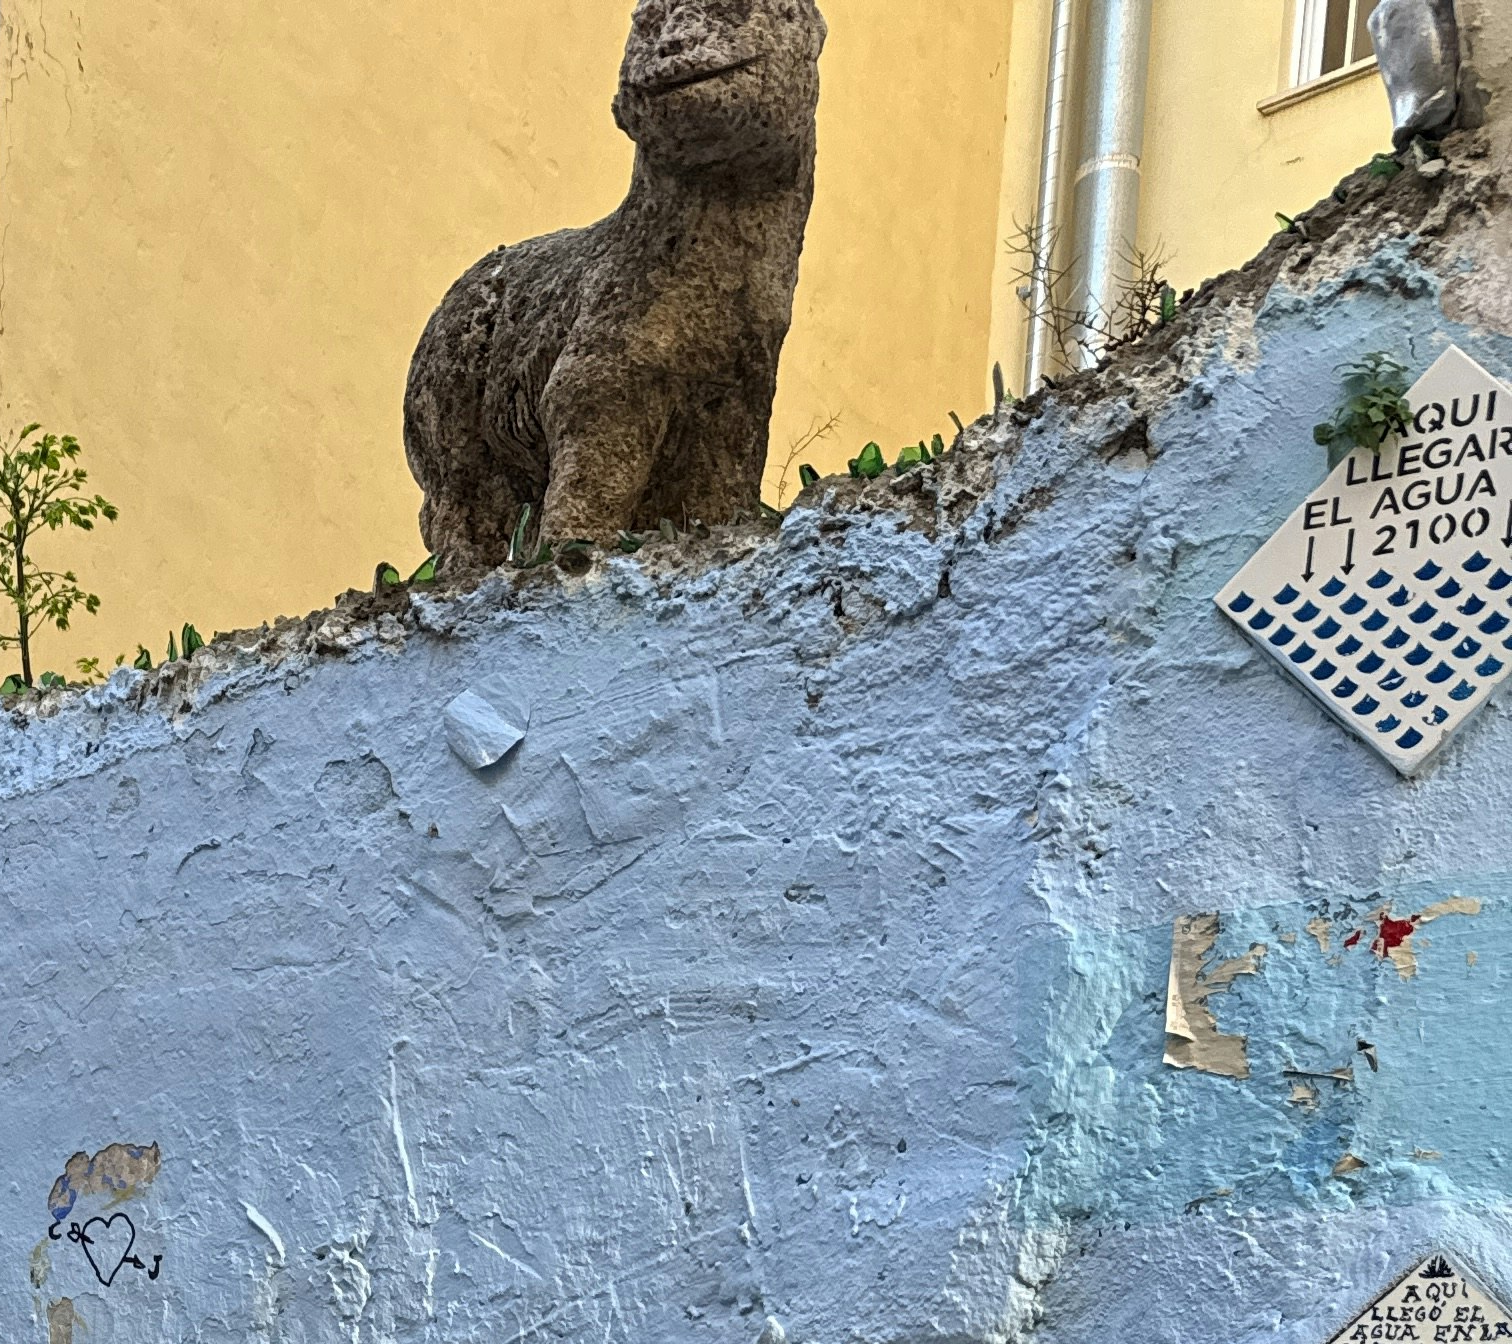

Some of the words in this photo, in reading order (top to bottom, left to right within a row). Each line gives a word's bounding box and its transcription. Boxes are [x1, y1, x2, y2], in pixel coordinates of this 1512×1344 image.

[1303, 497, 1353, 530] EL
[1370, 469, 1497, 519] AGUA
[1372, 506, 1490, 556] 2100
[1371, 1300, 1448, 1322] LLEGÓ
[1453, 1304, 1485, 1323] EL
[1349, 1323, 1420, 1341] AGUA
[1433, 1324, 1476, 1343] EN
